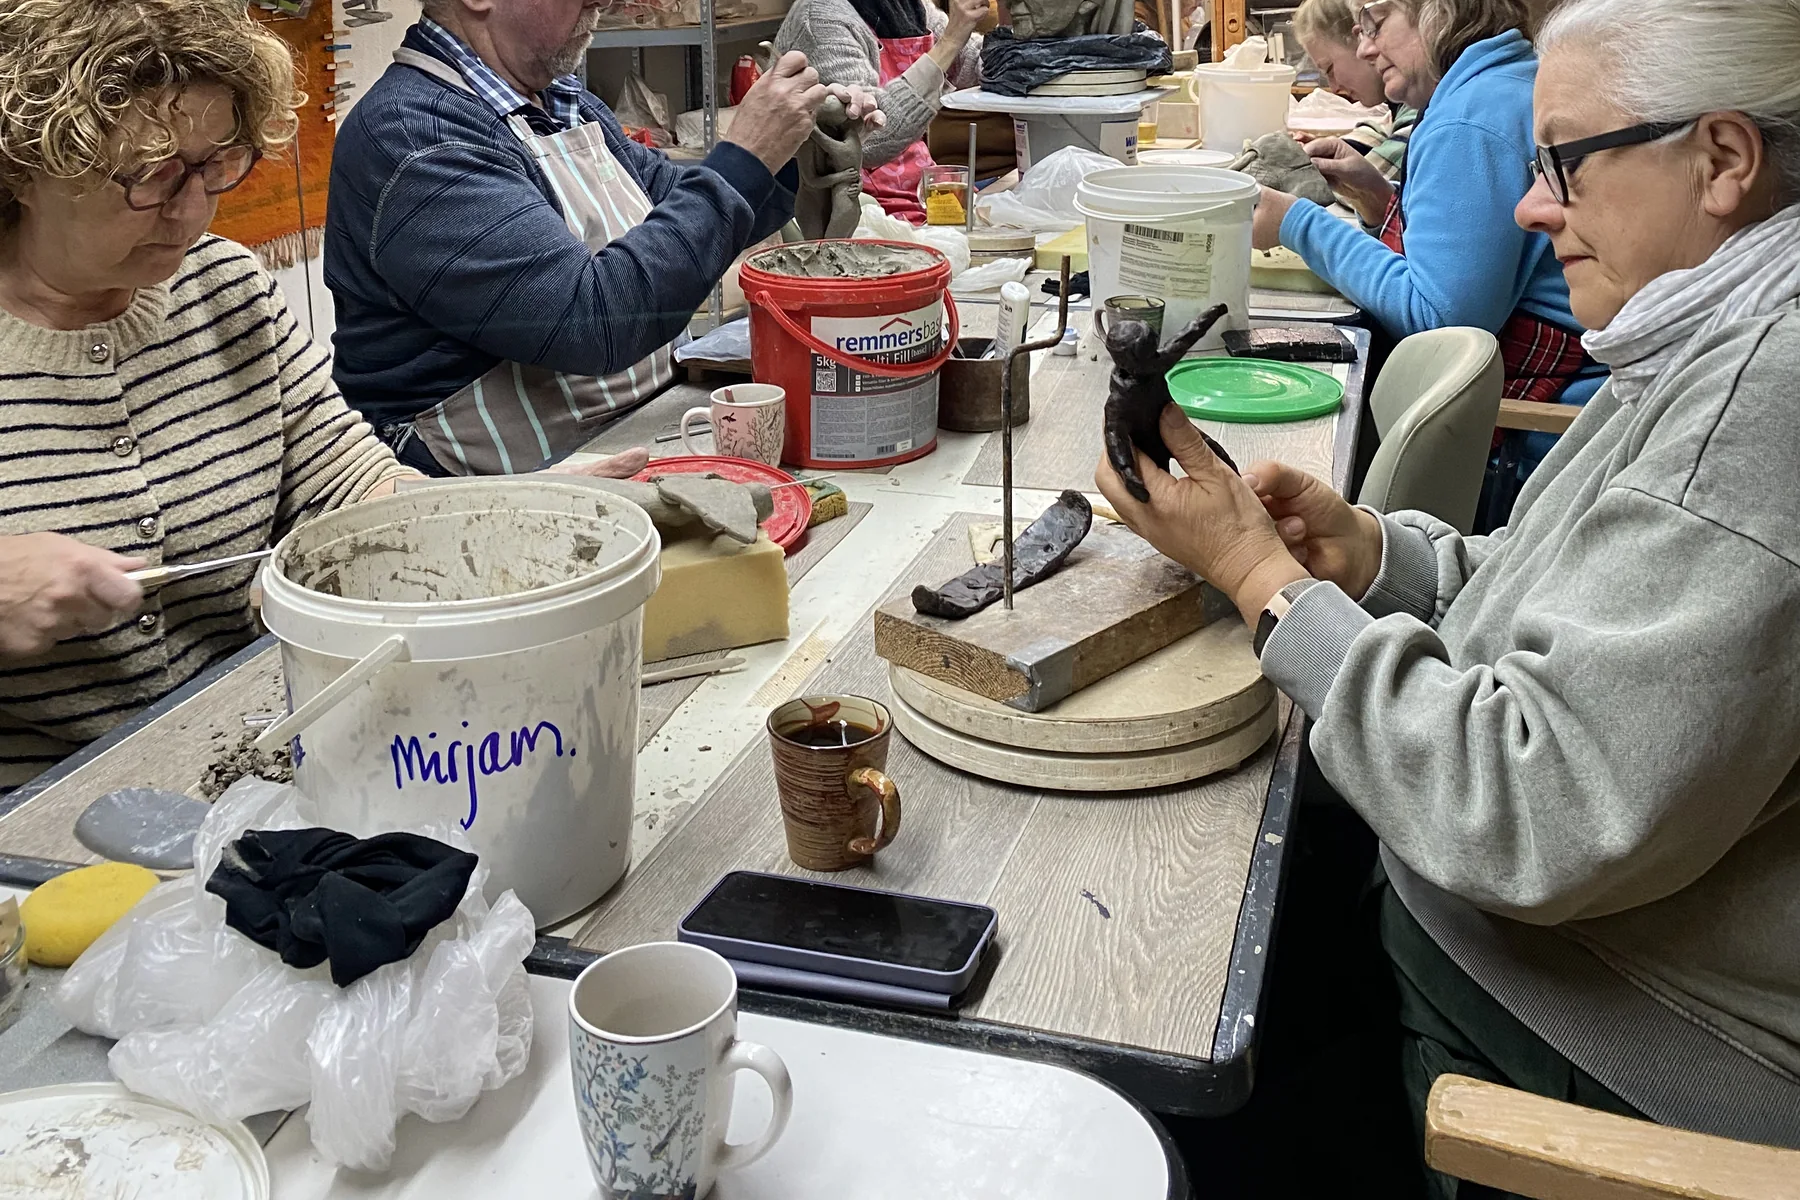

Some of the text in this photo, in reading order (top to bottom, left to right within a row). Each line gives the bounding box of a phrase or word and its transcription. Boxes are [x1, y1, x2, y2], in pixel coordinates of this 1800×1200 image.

[816, 355, 837, 370] 5kg
[894, 349, 910, 365] Fill
[390, 720, 577, 831] Mirjam.
